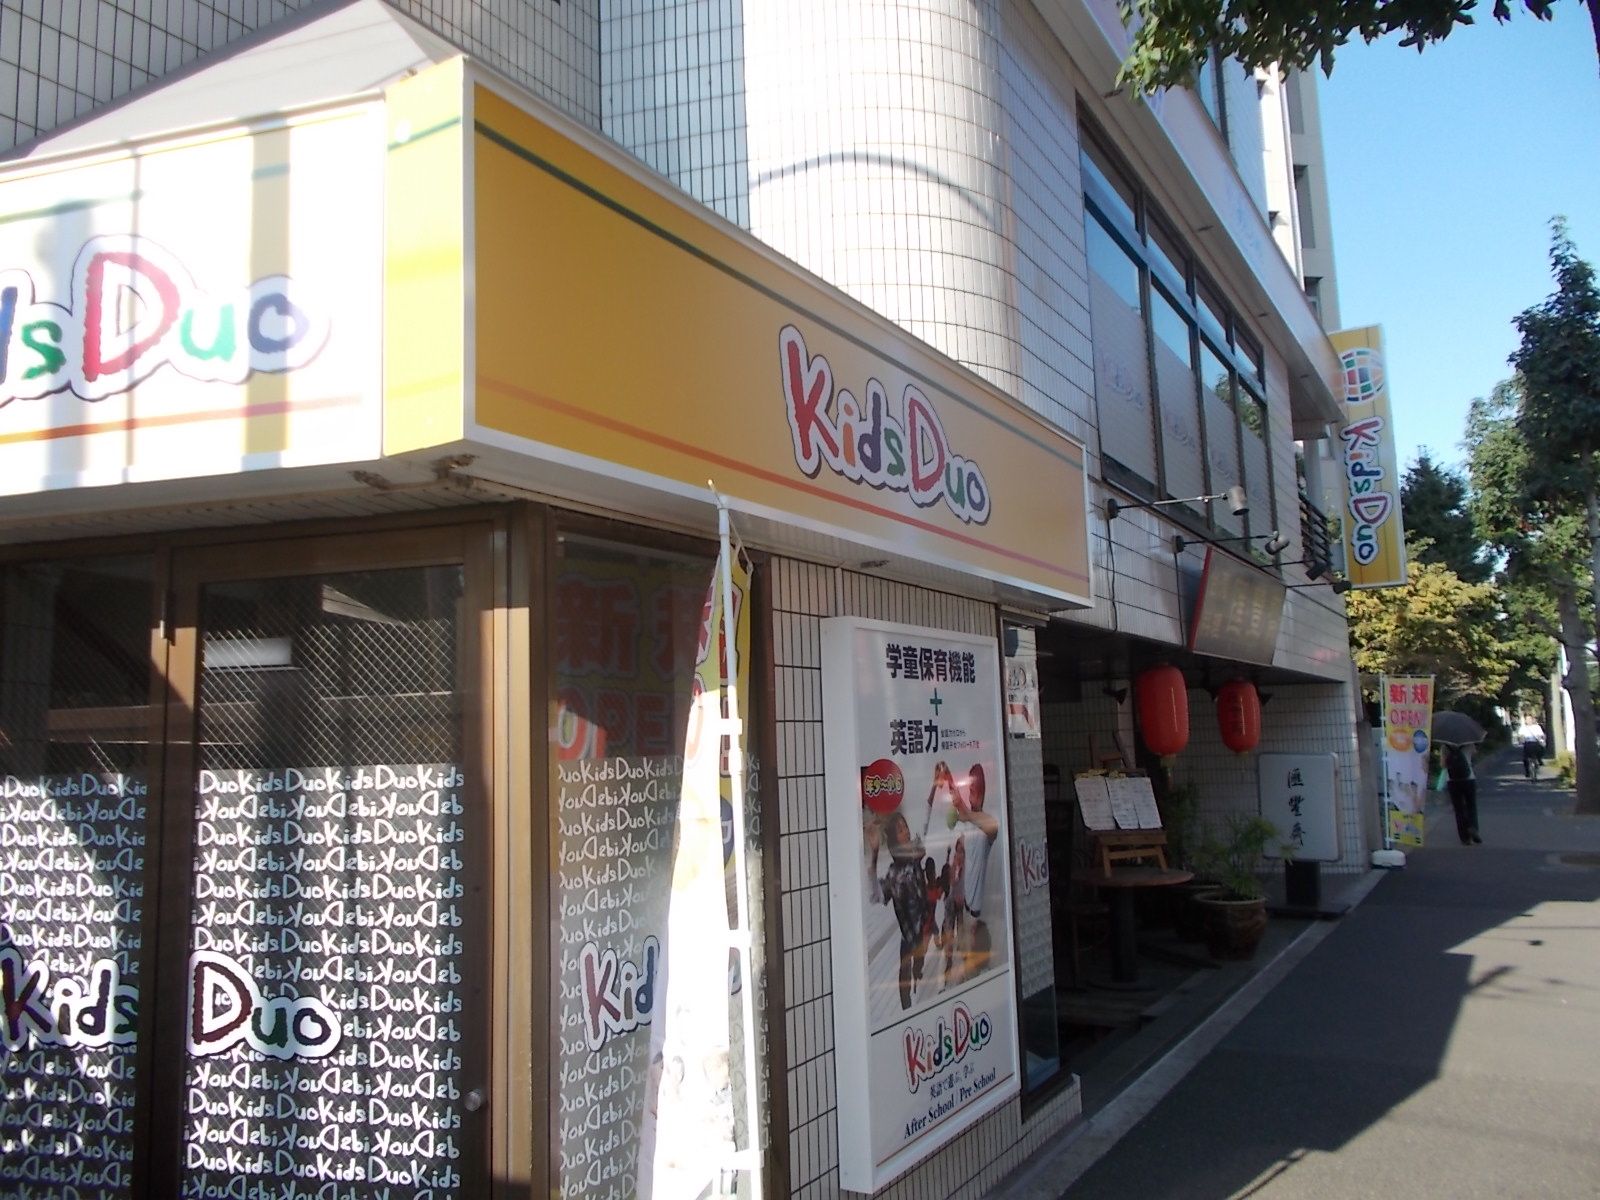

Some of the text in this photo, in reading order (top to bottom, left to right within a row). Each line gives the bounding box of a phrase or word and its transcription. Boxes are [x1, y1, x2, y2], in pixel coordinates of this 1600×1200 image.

[785, 336, 987, 513] KidsDuo
[1344, 417, 1391, 561] KidsDuo
[885, 643, 977, 684] 学童保育機能
[889, 719, 940, 756] 英語力
[192, 960, 333, 1046] Duo
[904, 1006, 990, 1086] KidsDuo
[904, 1116, 927, 1140] After
[928, 1094, 955, 1123] School
[973, 1067, 996, 1093] School
